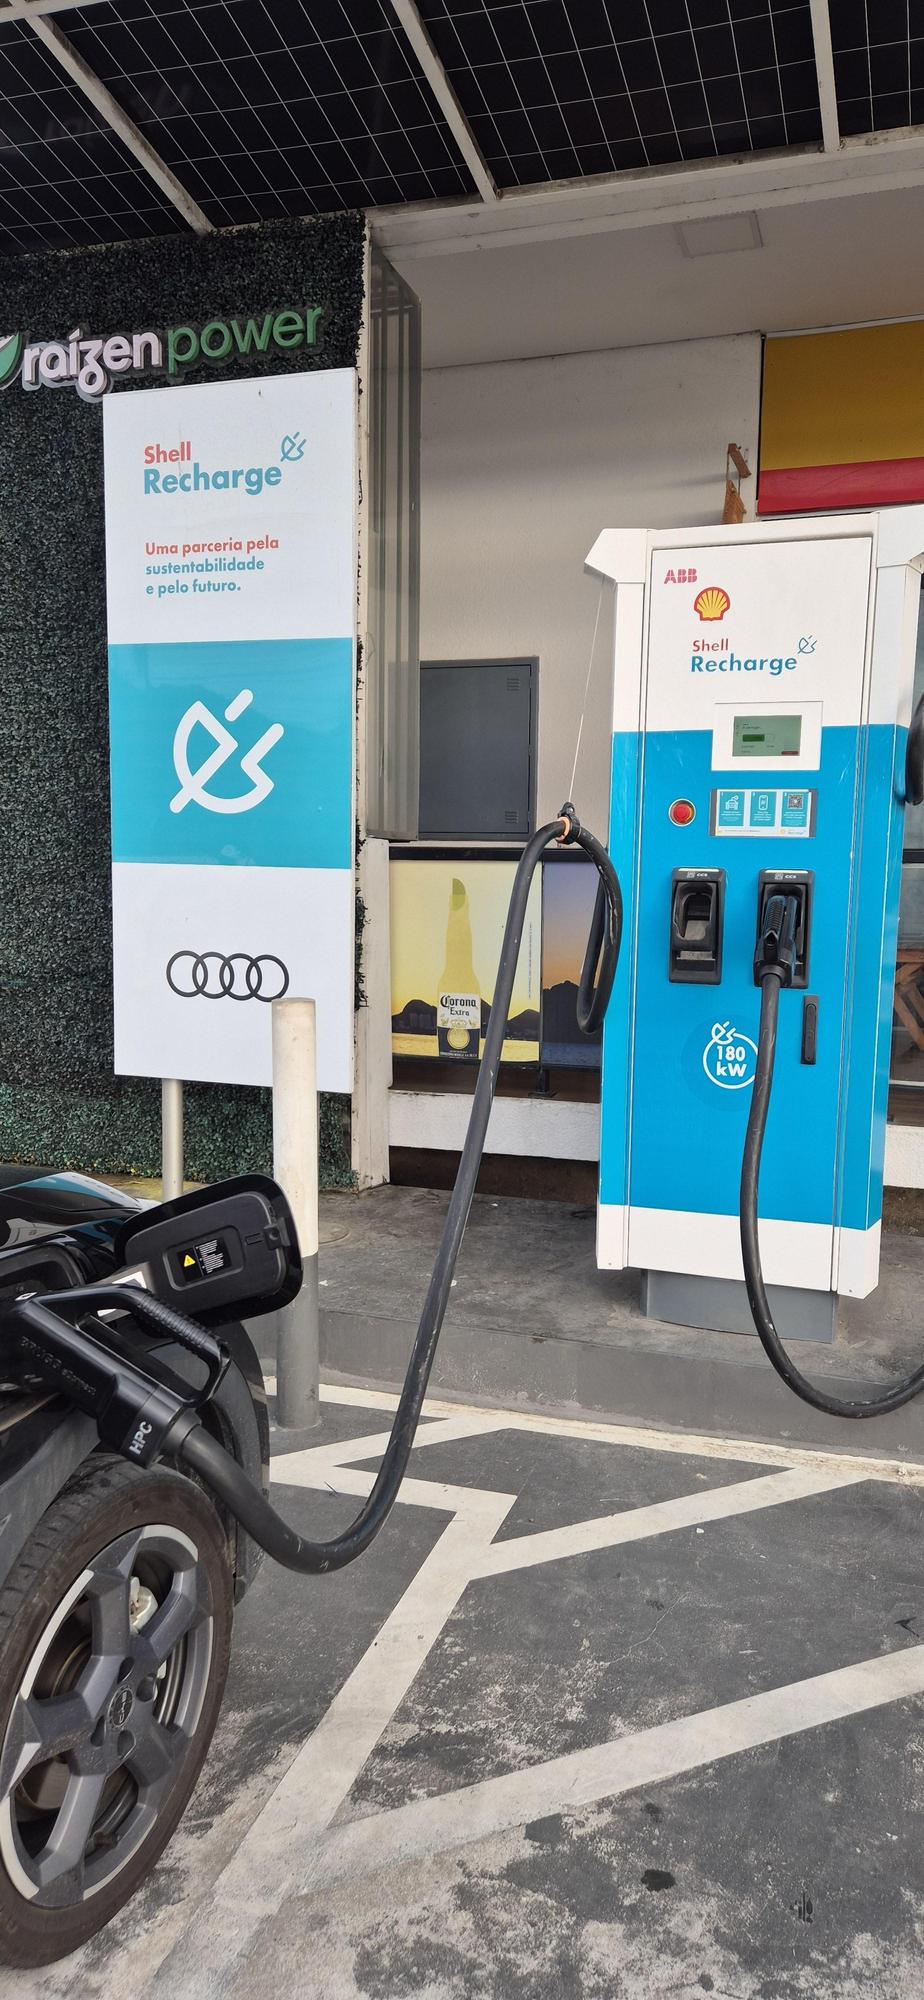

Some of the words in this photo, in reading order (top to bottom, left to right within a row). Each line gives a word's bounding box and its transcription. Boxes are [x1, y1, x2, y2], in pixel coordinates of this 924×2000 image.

[23, 328, 162, 394] raízen
[167, 306, 323, 374] power
[143, 441, 191, 464] Shell
[143, 462, 282, 496] Recharge
[145, 541, 178, 556] Uma
[182, 538, 243, 557] parceria
[246, 535, 279, 554] pela
[145, 556, 265, 576] sustentabilidade
[664, 568, 698, 584] ABB
[146, 584, 154, 595] e
[158, 579, 189, 598] pelo
[192, 577, 242, 593] futuro.
[692, 638, 729, 652] Shell
[690, 653, 797, 676] Recharge
[440, 995, 477, 1009] Corona
[450, 1007, 470, 1016] Extra
[716, 1046, 746, 1061] 180
[716, 1061, 747, 1077] kW
[128, 1420, 153, 1455] HPC
